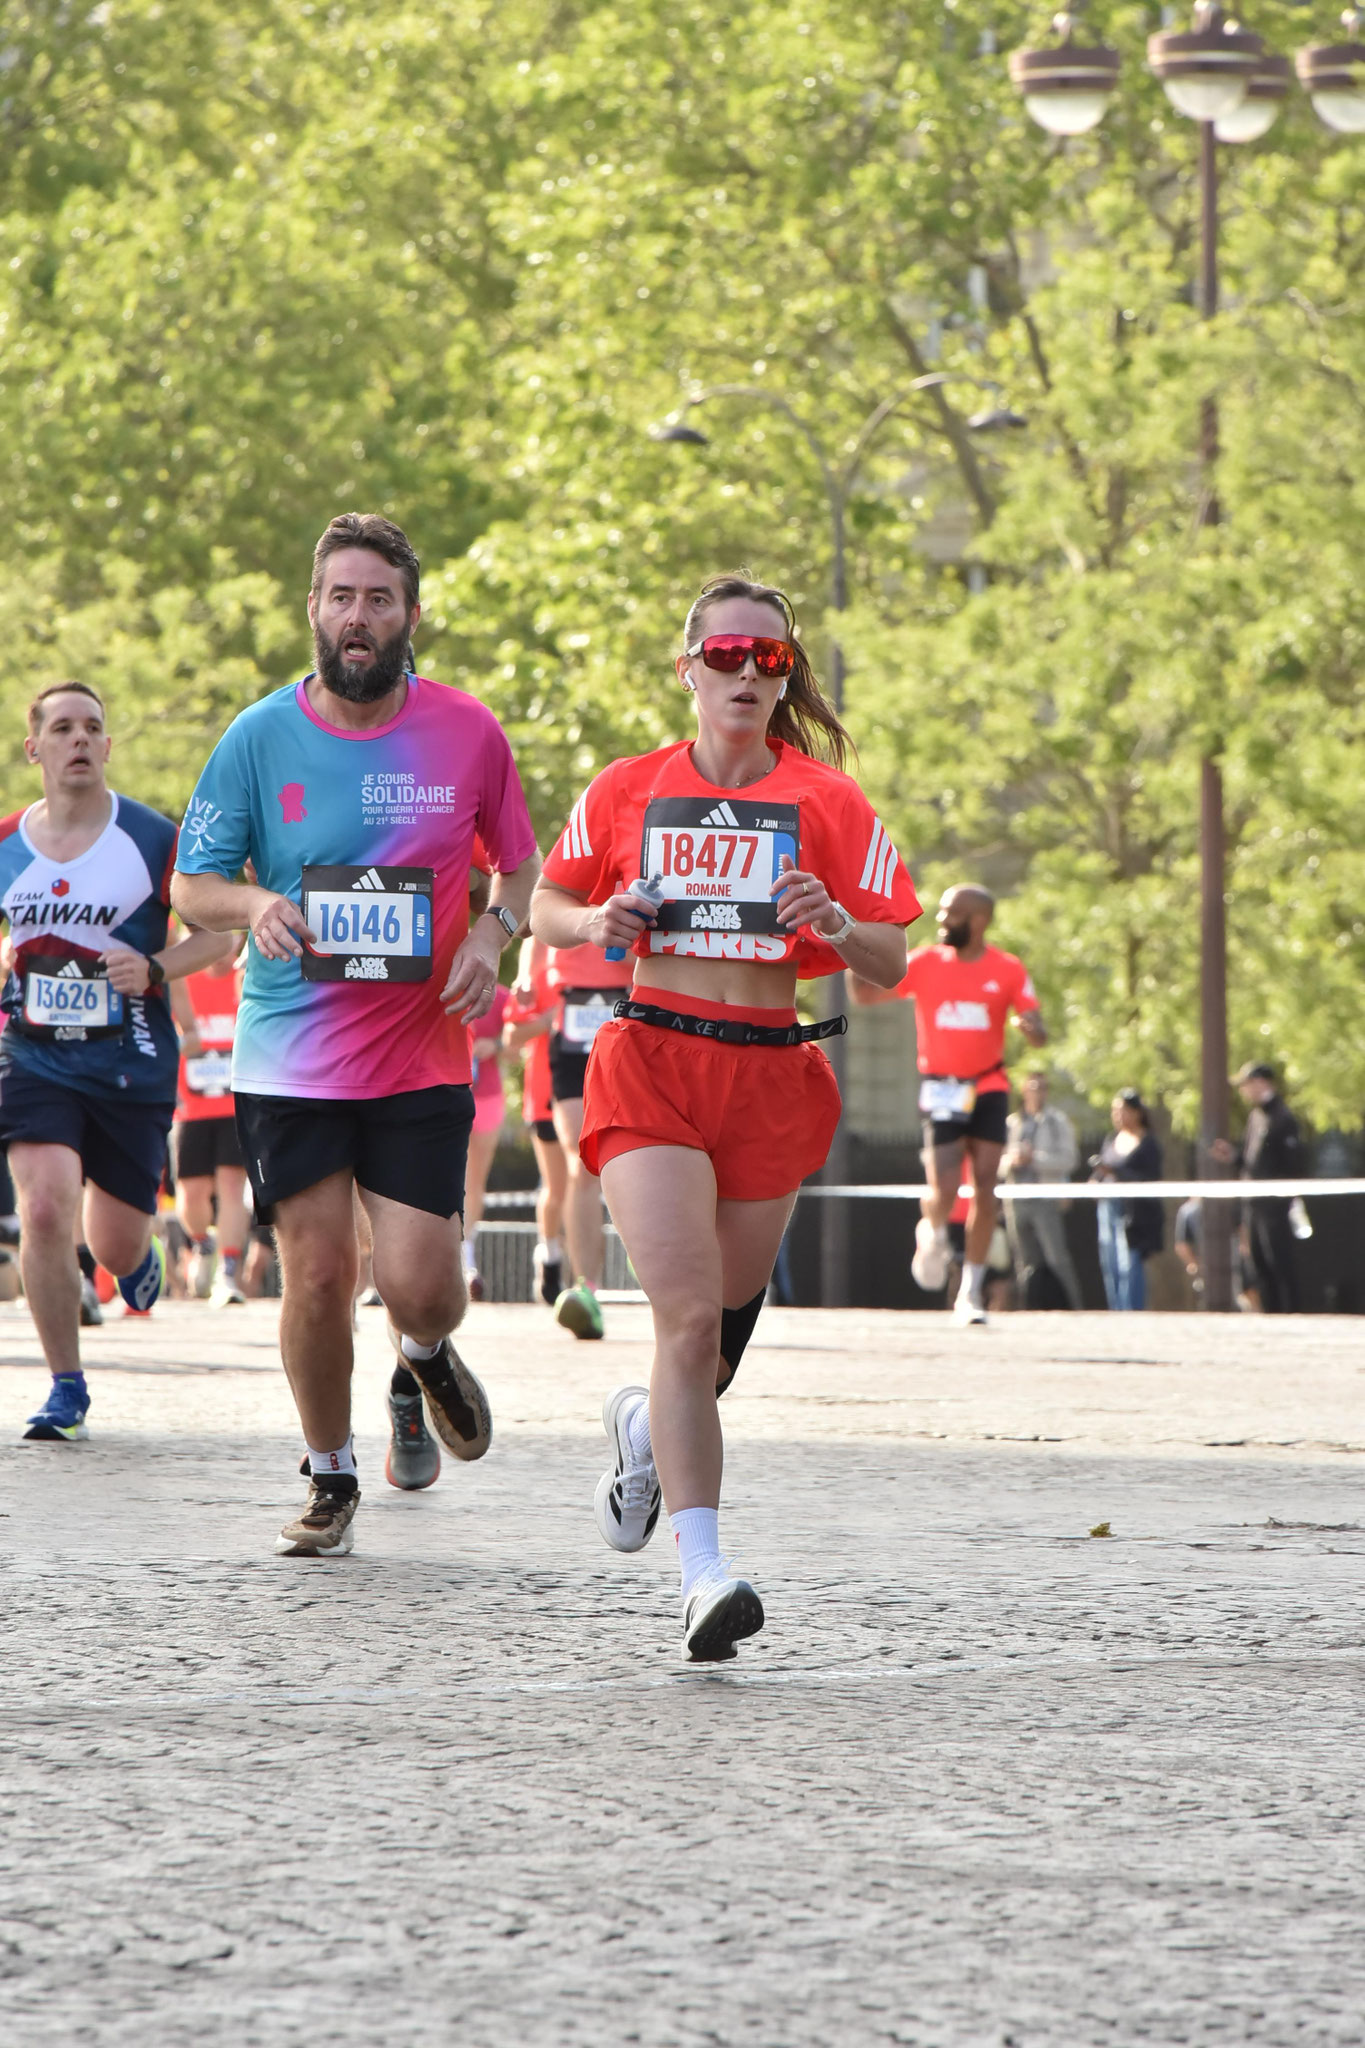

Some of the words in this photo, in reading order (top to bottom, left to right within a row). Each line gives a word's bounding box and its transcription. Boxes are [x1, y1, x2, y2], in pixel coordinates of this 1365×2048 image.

[361, 774, 375, 785] JE
[377, 773, 415, 785] COURS
[361, 785, 456, 804] SOLIDAIRE
[362, 806, 383, 814] POUR
[385, 804, 413, 814] GUÉRIR
[415, 805, 424, 813] LE
[426, 805, 455, 813] CANCER
[363, 817, 374, 825] AU
[390, 815, 417, 825] SIÈCLE
[755, 818, 760, 828] 7
[760, 818, 778, 829] JUIN
[661, 832, 759, 879] 18477
[398, 882, 403, 891] 7
[403, 882, 417, 891] JUIN
[685, 883, 732, 897] ROMANE
[13, 891, 45, 902] TEAM
[10, 903, 118, 927] TAIWAN
[709, 904, 740, 917] 10K
[320, 903, 400, 944] 16146
[416, 913, 426, 928] MIN
[690, 915, 742, 929] PARIS
[416, 928, 426, 937] 47
[650, 931, 787, 960] PARIS
[360, 957, 387, 969] 10K
[344, 966, 389, 979] PARIS
[36, 978, 98, 1010] 13626
[129, 997, 157, 1057] IWAN
